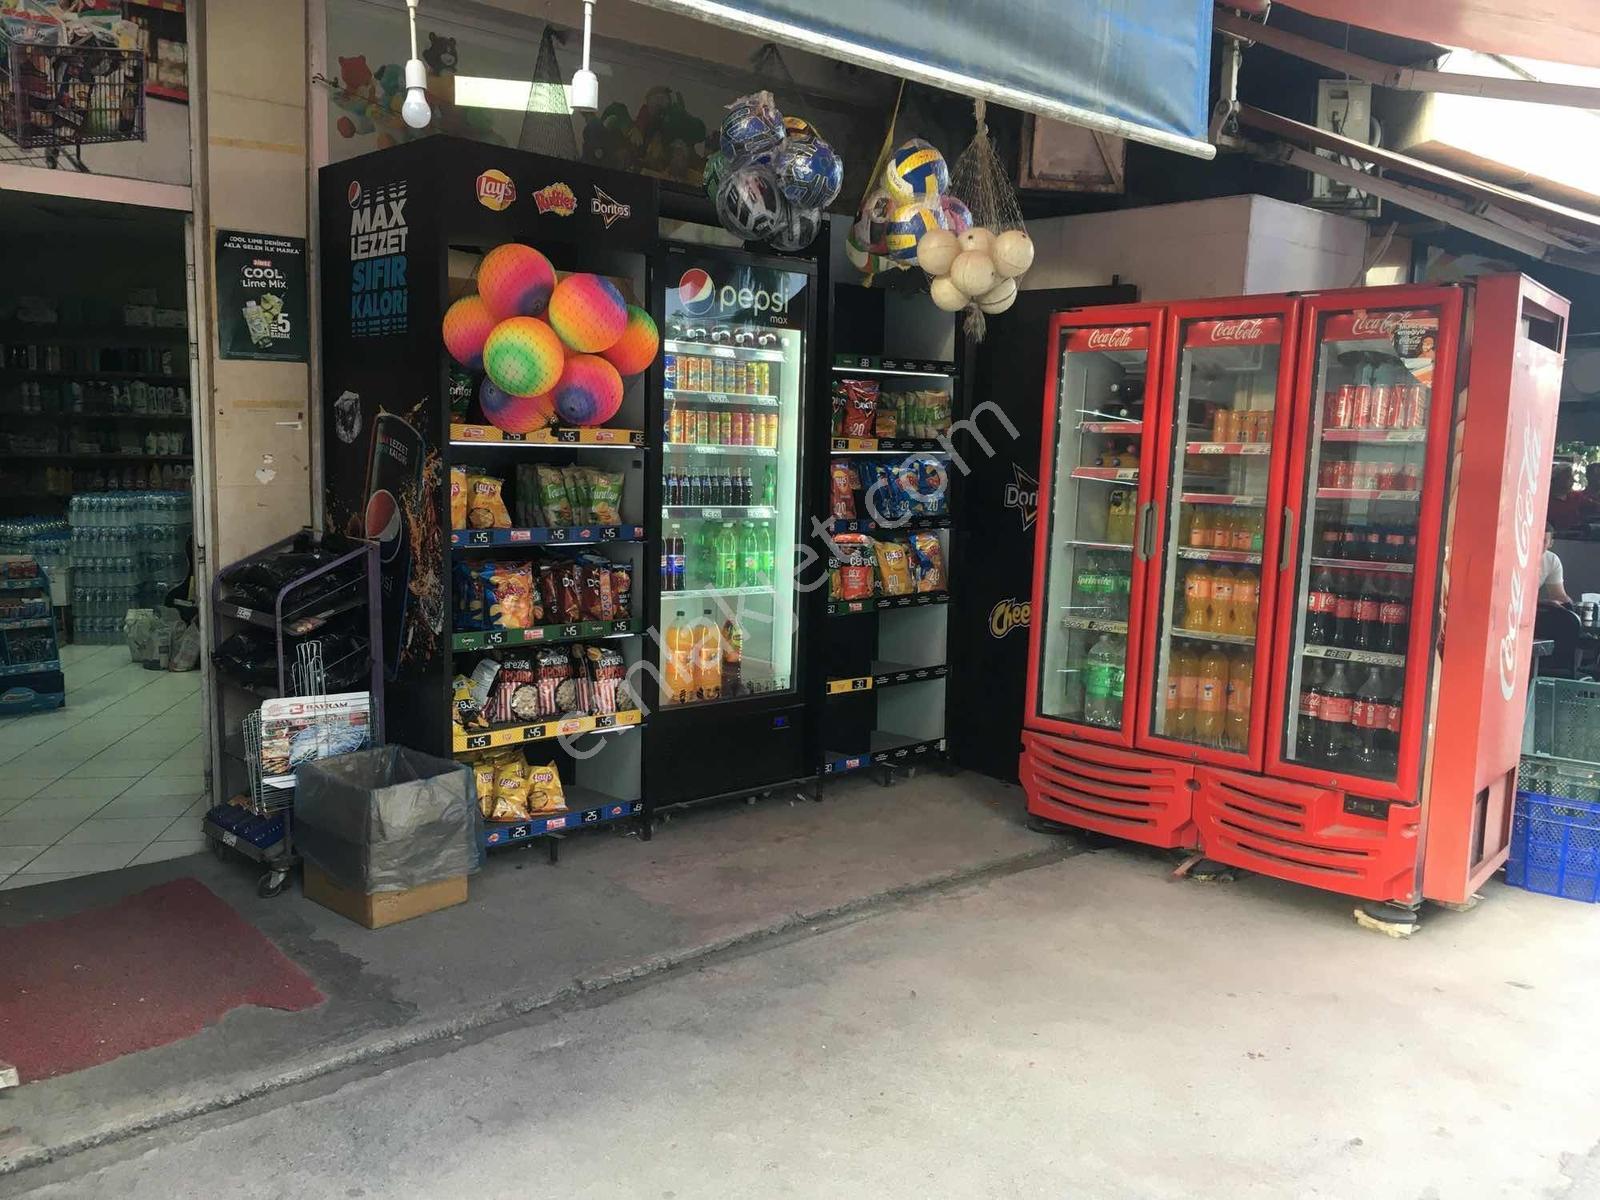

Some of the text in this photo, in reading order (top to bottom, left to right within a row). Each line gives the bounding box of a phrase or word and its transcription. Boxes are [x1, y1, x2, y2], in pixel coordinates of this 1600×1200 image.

[480, 176, 513, 204] Lay's
[351, 198, 408, 236] MAX
[592, 199, 631, 217] Doritos
[351, 227, 409, 261] LEZZET
[242, 279, 286, 289] Lime Mix
[244, 268, 283, 279] COOL
[352, 255, 408, 293] SIFIR
[719, 285, 790, 317] pepsi
[278, 313, 291, 333] 5
[769, 314, 788, 325] max
[1211, 319, 1264, 342] Coca-Cola
[1088, 327, 1134, 349] Coca-Cola
[1006, 485, 1038, 506] Dori
[1499, 414, 1541, 701] Coca-Cola
[991, 600, 1030, 637] Chee
